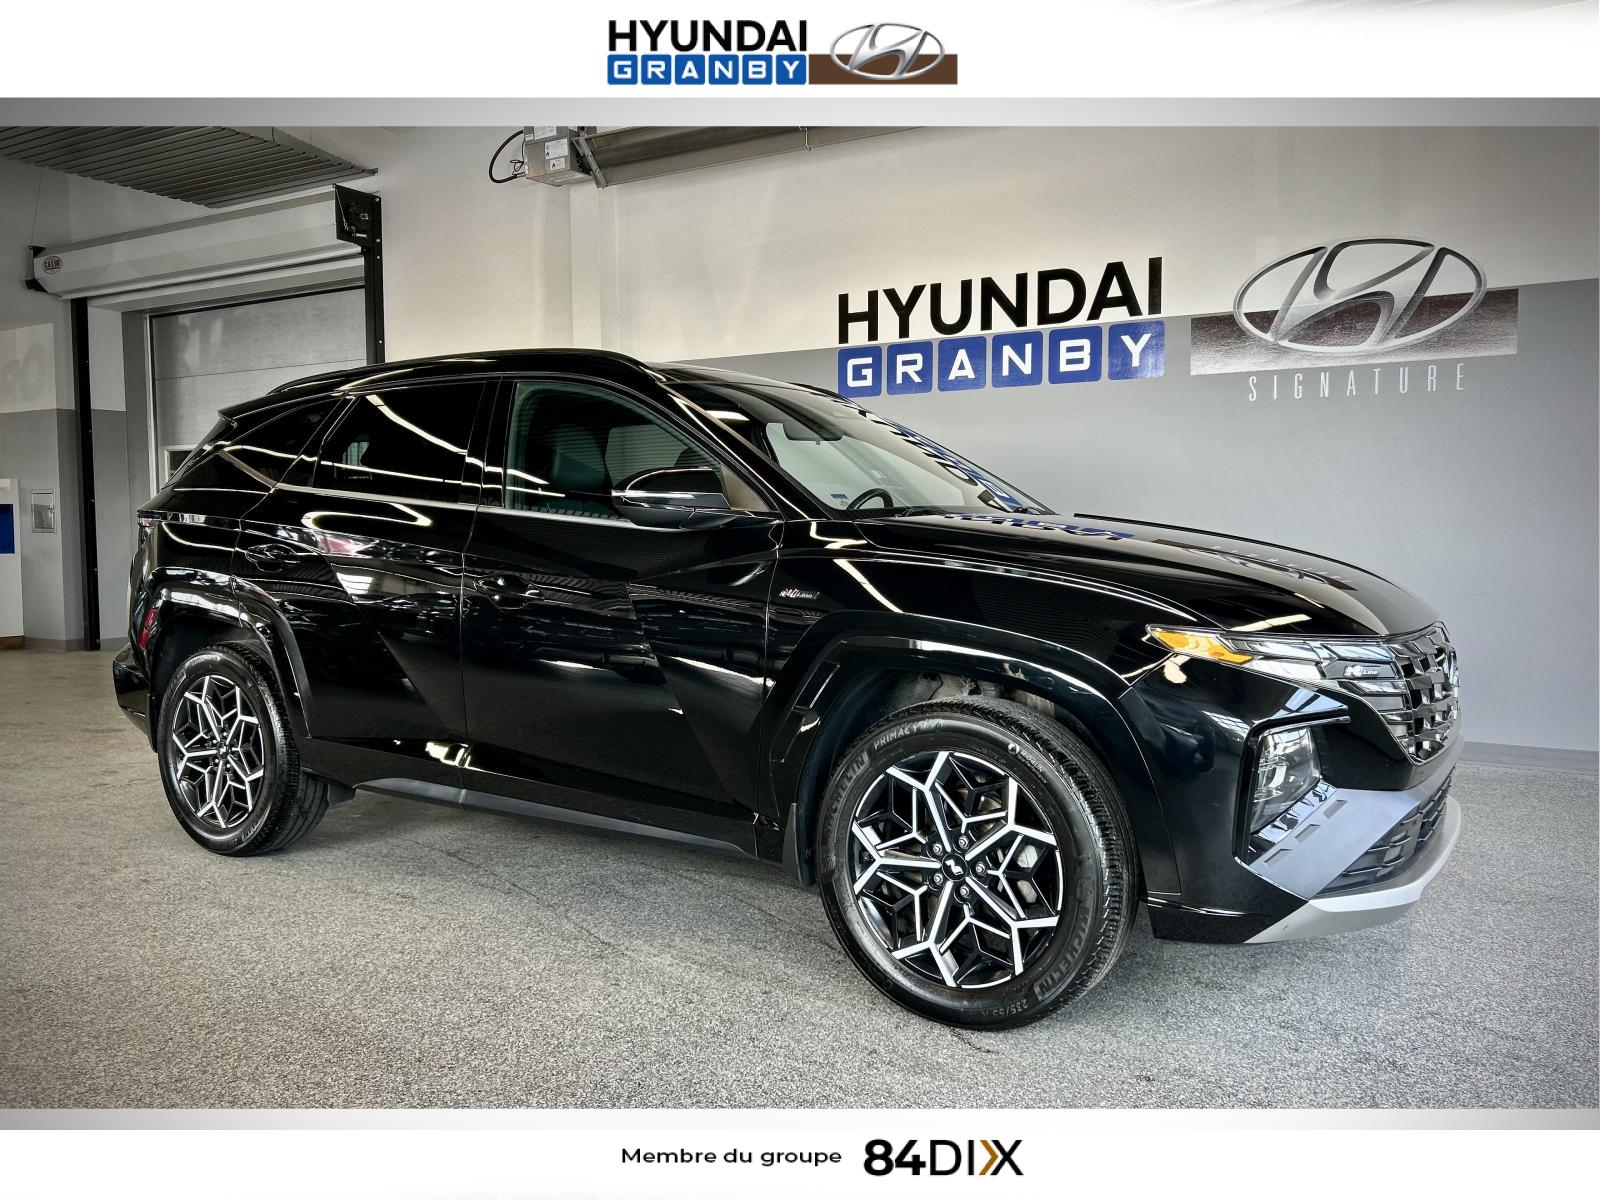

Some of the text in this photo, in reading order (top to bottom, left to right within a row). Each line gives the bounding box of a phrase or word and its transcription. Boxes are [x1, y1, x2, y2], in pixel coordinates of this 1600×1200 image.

[838, 256, 1163, 345] HYUNDAI
[846, 333, 1152, 389] GRANBY
[1247, 361, 1466, 402] SIGNATURE
[873, 721, 918, 750] PRIMACY
[1038, 909, 1090, 993] MICHELIN
